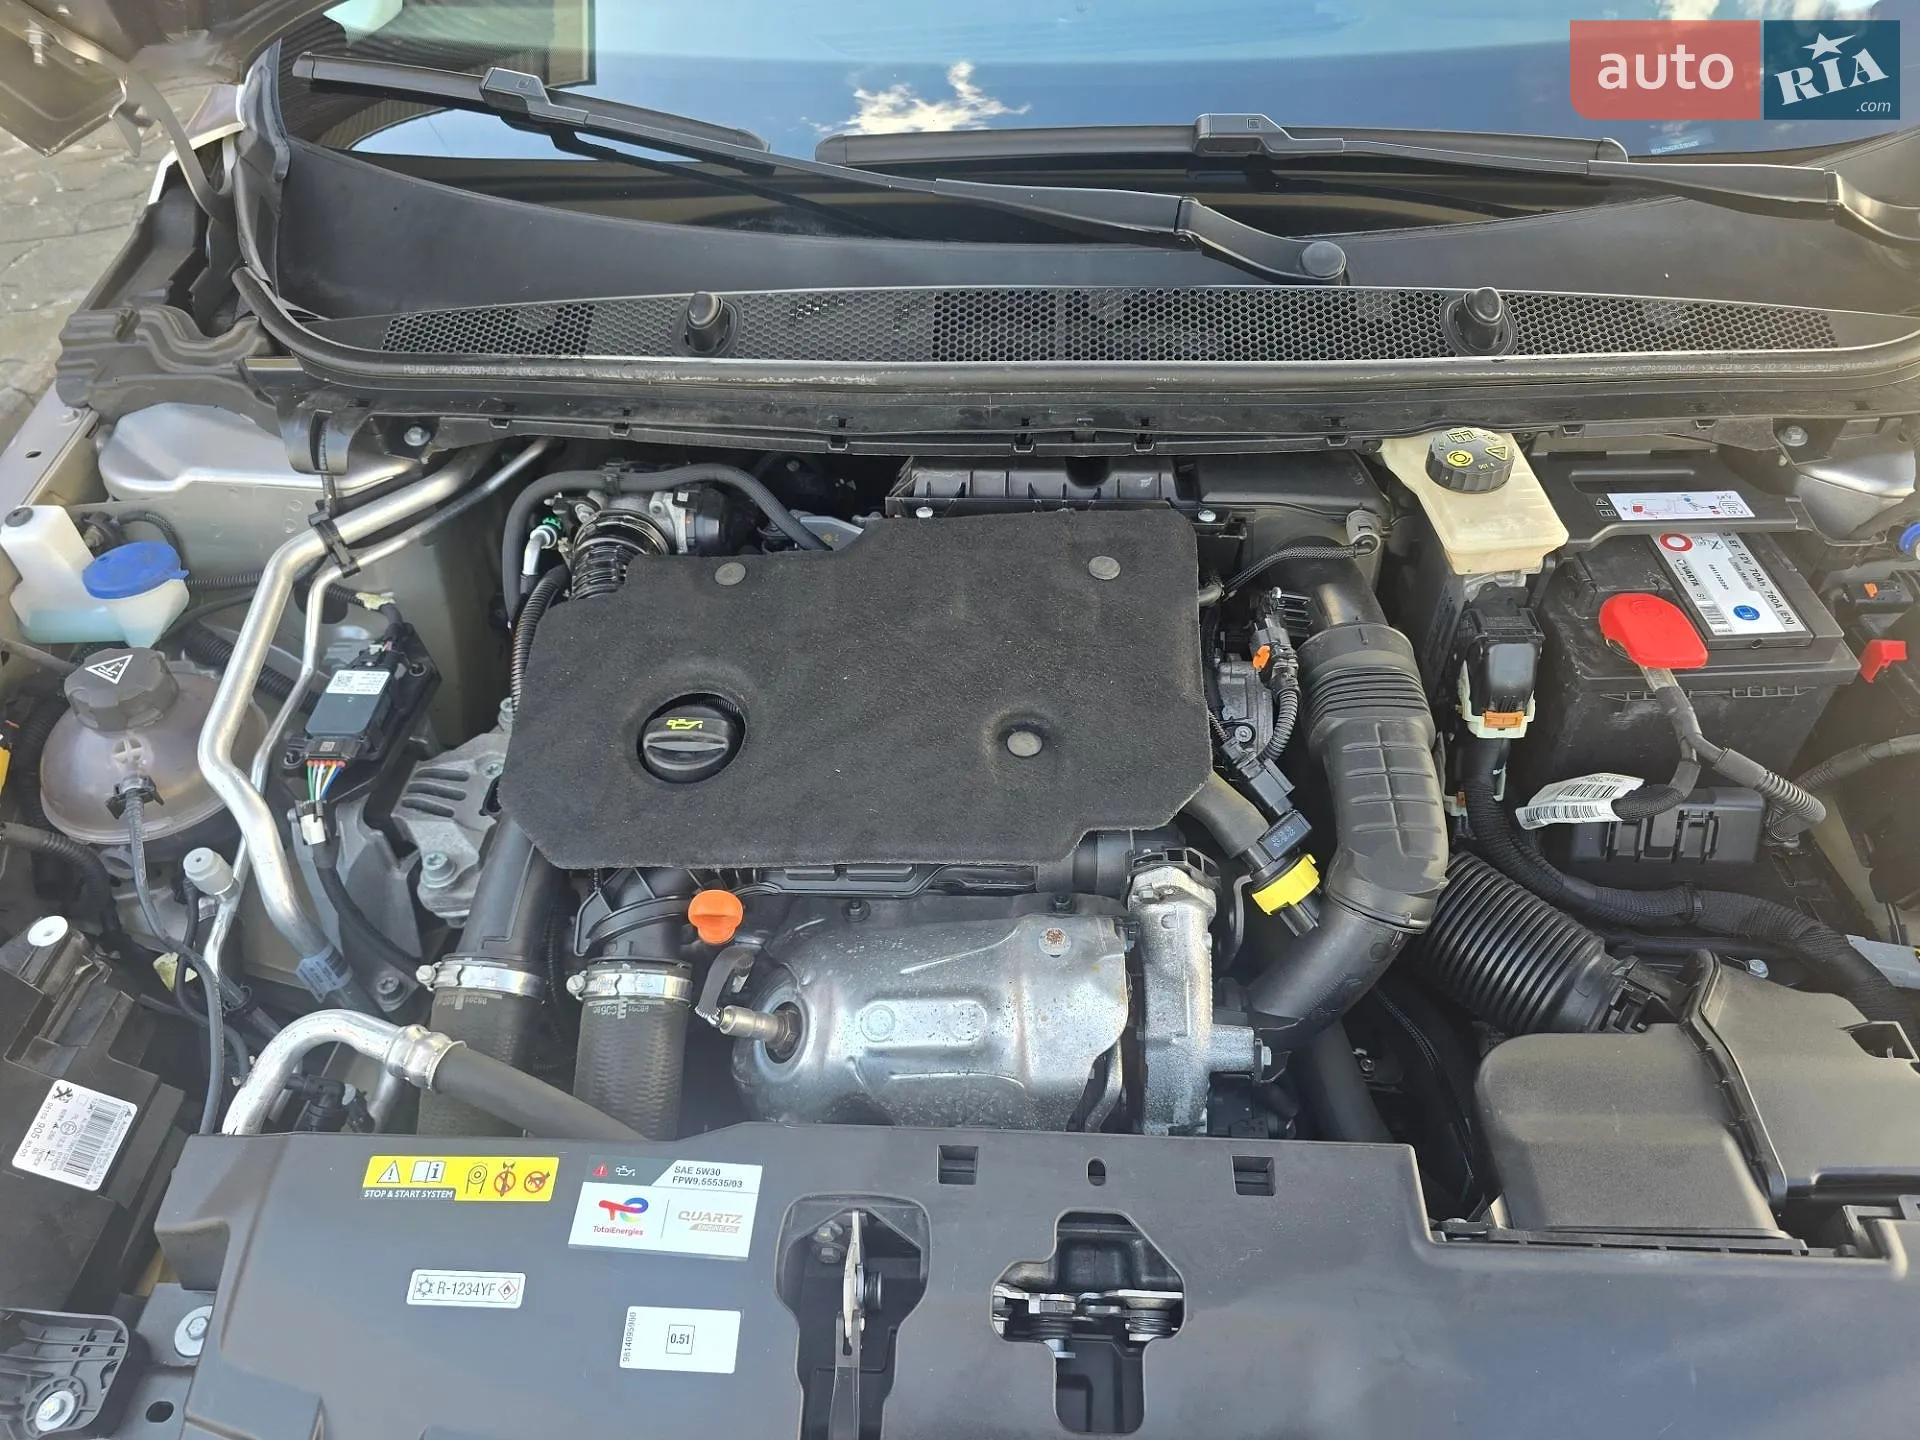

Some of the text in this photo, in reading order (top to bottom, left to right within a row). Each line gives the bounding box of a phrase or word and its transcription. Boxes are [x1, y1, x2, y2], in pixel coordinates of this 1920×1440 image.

[1681, 565, 1700, 587] VARTA
[1737, 552, 1753, 566] 12V
[1749, 567, 1766, 587] 70Ah
[674, 1165, 721, 1177] SAE 5W30
[364, 1189, 454, 1199] STOP & START SYSTEM
[678, 1210, 743, 1224] QUARTZ
[593, 1225, 644, 1237] TotalEnergies
[437, 1281, 497, 1296] R-1234YF
[670, 1333, 690, 1345] 0.51
